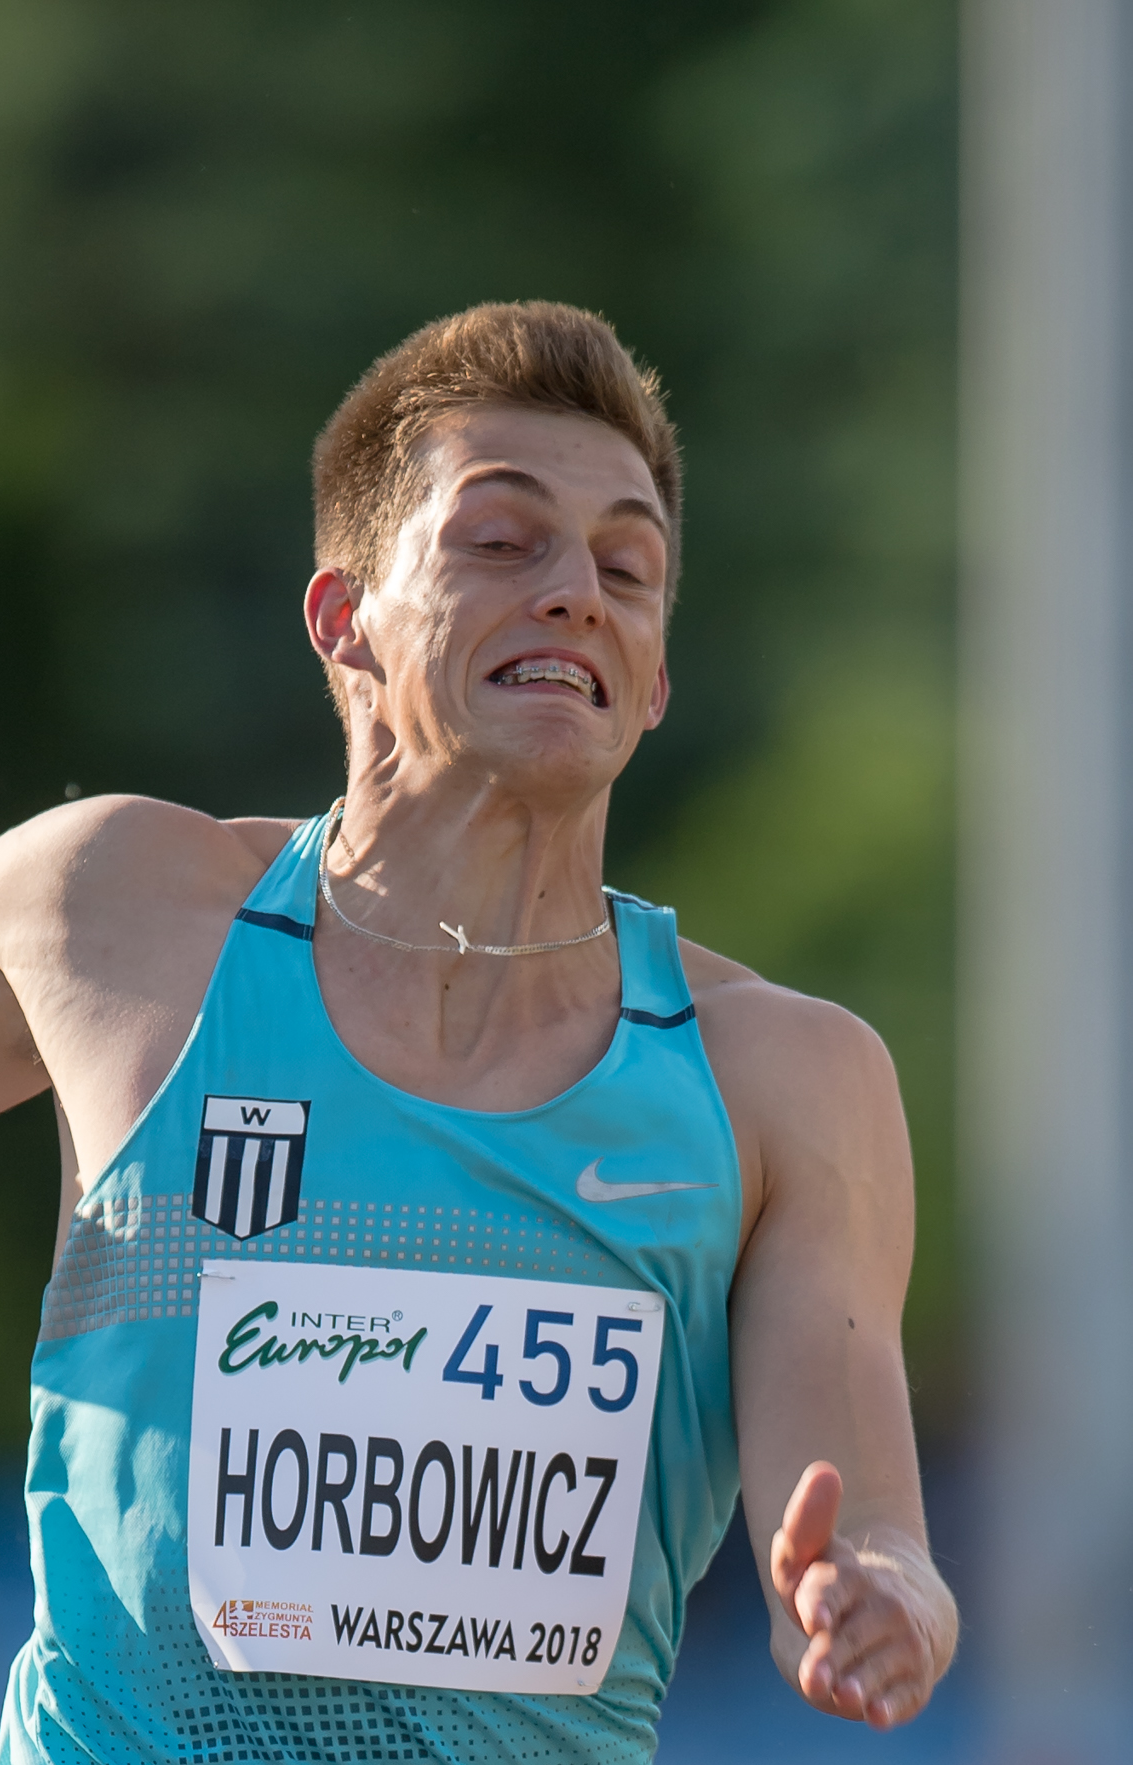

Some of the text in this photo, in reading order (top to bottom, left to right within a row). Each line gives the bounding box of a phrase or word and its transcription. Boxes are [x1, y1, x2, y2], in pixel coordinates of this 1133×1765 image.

[240, 1106, 271, 1126] W
[218, 1300, 427, 1384] Europol
[442, 1304, 643, 1413] 455
[214, 1427, 619, 1578] HORBOWICZ
[230, 1622, 312, 1640] SZELESTA
[254, 1612, 313, 1623] ZYGMUNTA
[330, 1604, 602, 1667] WARSZAWA 2018
